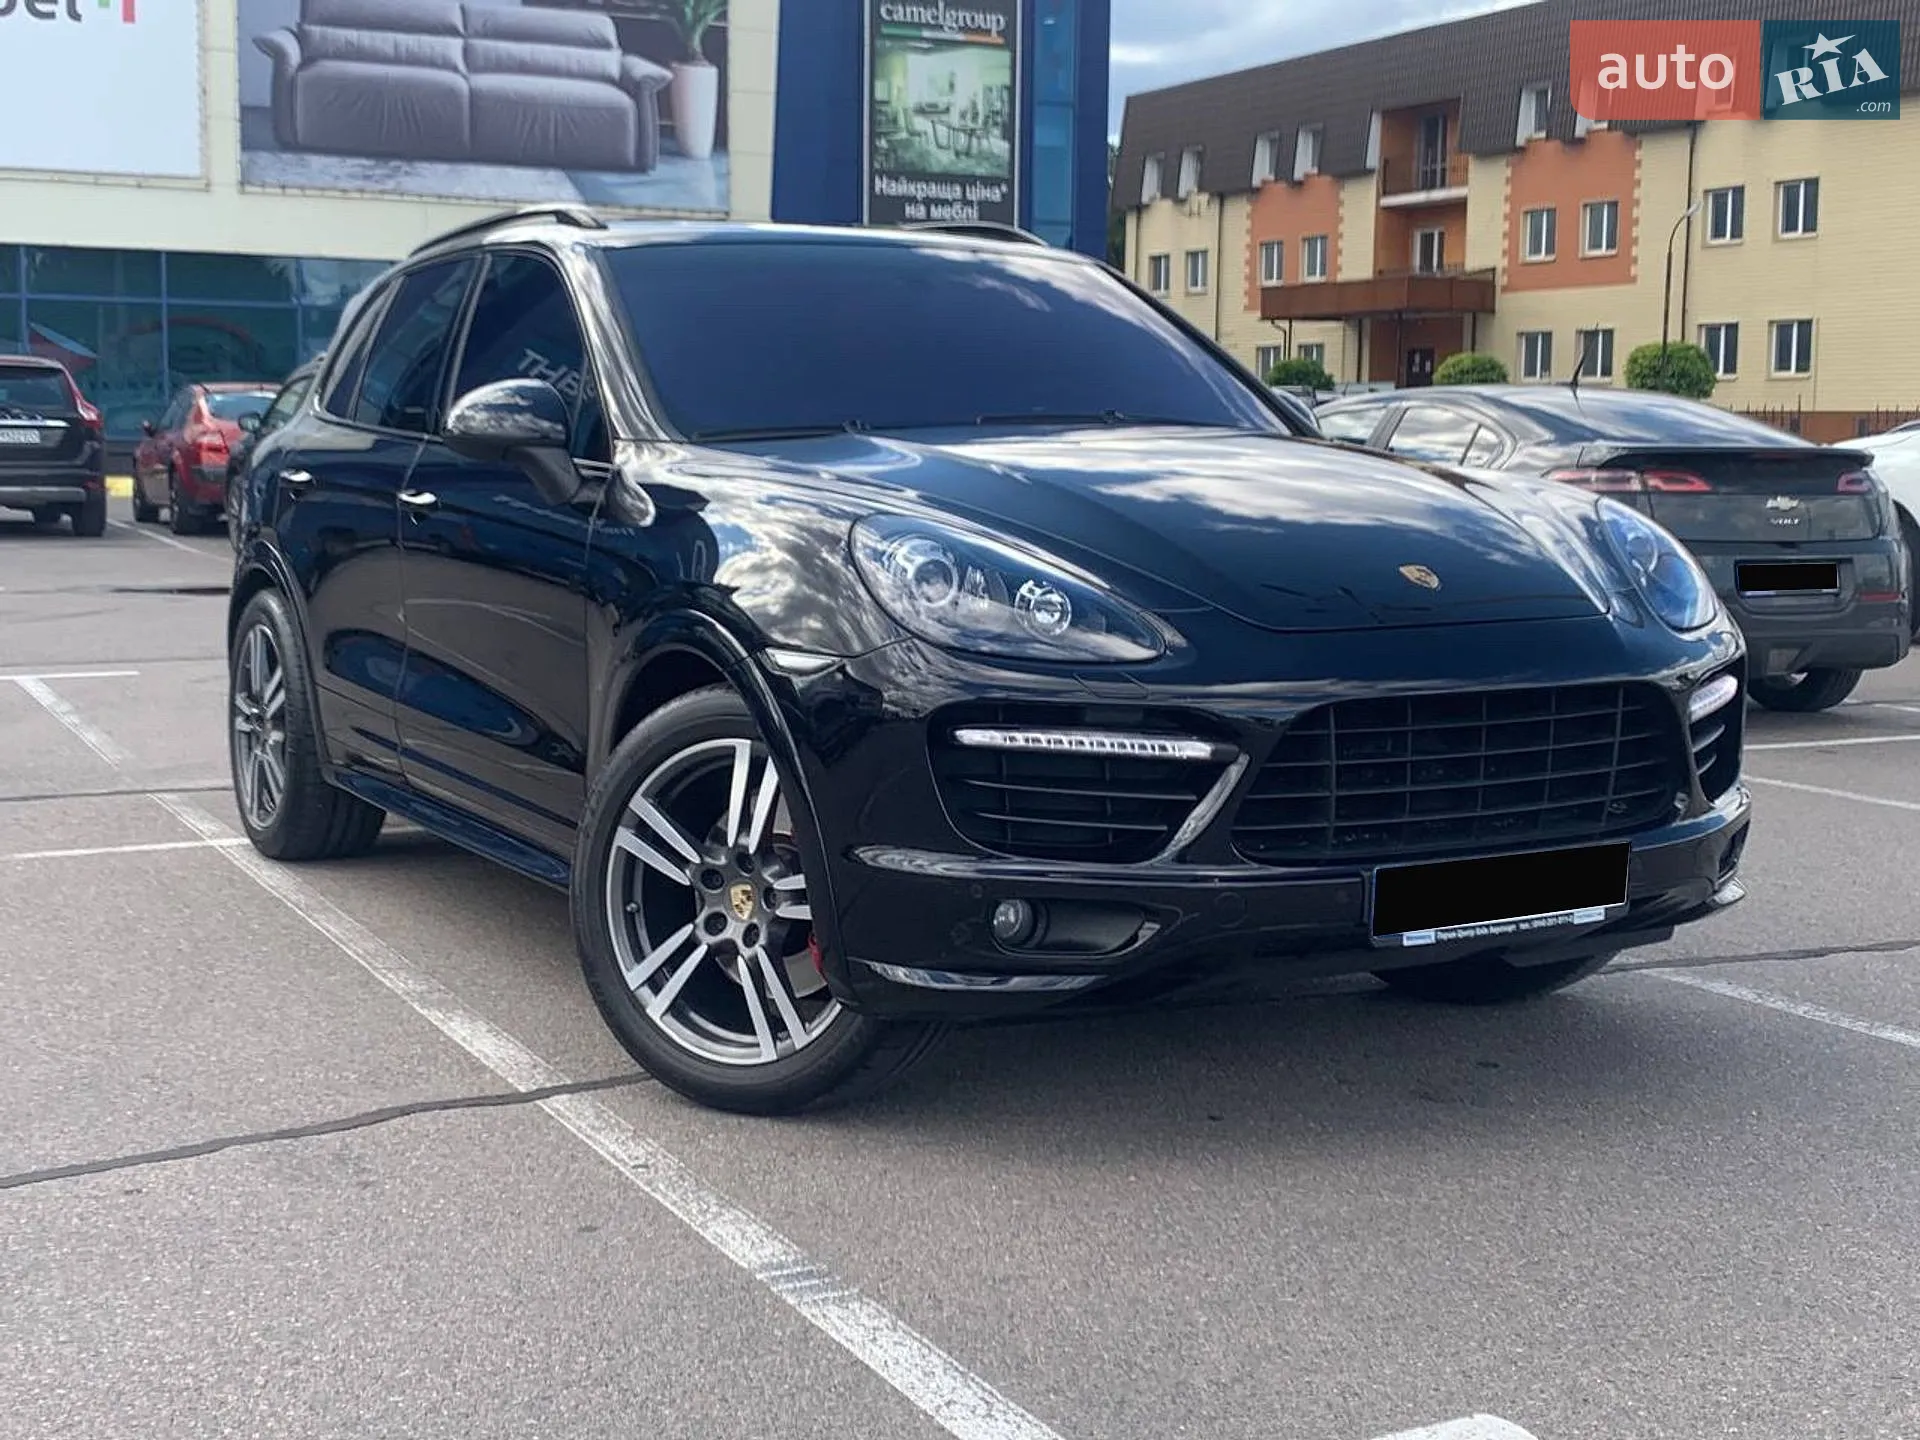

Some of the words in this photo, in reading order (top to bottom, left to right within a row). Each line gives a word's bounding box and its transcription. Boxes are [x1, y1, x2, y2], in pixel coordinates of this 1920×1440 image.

[880, 0, 1006, 38] camelgroup
[874, 173, 962, 201] Найкраща
[904, 202, 926, 219] на
[929, 201, 979, 220] меблі
